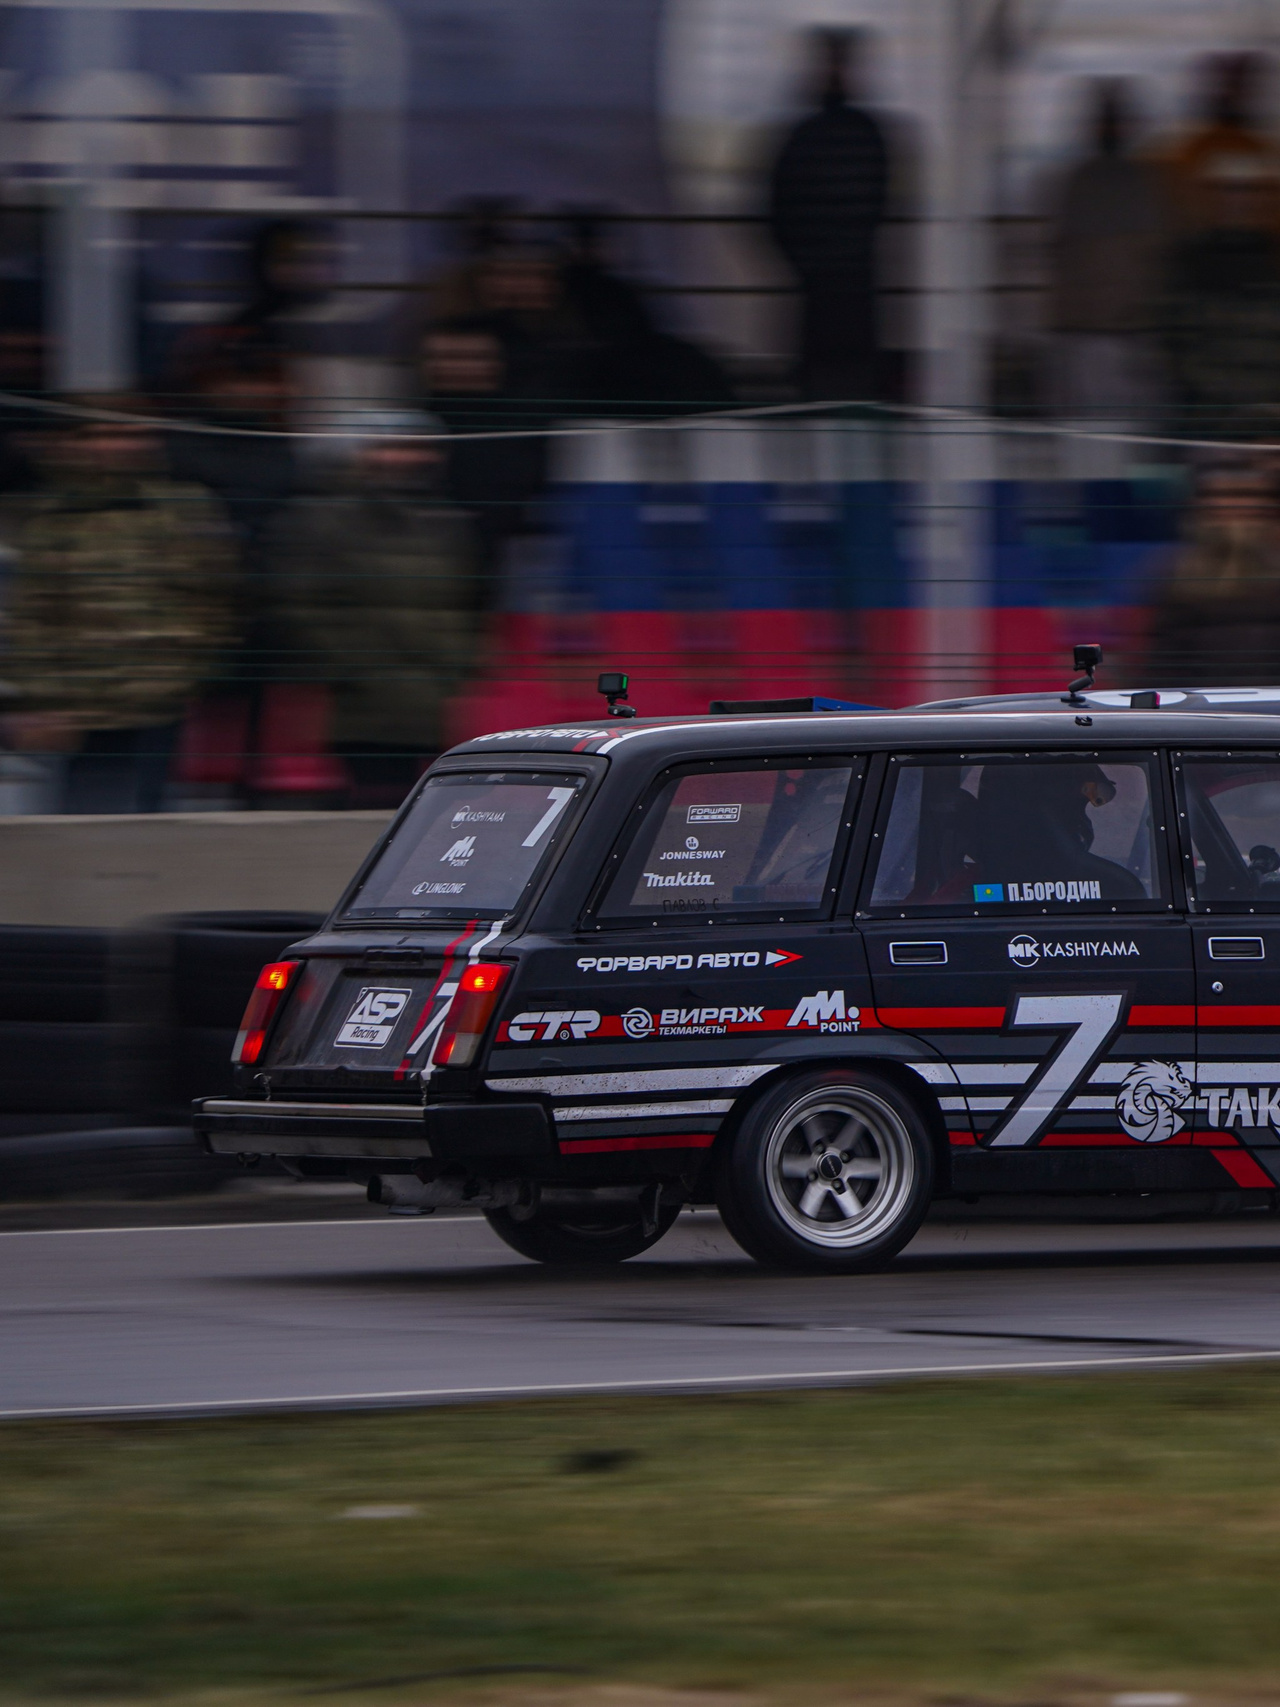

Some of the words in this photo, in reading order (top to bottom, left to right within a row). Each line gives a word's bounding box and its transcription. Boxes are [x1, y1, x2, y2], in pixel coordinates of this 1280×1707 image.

[466, 811, 506, 823] KASHIYAMA
[521, 787, 576, 847] 7
[690, 807, 738, 815] FORWARD
[450, 858, 469, 867] POINT
[659, 850, 726, 860] JONNESWAY
[426, 882, 466, 894] LINGLONG
[1007, 881, 1101, 902] П.БОРОДИН
[1043, 941, 1140, 957] KASHIYAMA
[577, 954, 693, 972] ФОРВАРД
[697, 952, 760, 968] АВТО
[347, 992, 407, 1024] ASP
[659, 1006, 765, 1025] ВИРАЖ
[508, 1010, 600, 1041] CTR
[658, 1024, 727, 1036] ТЕХМАРКЕТЫ
[820, 1021, 860, 1033] POINT
[350, 1026, 379, 1041] Racing
[990, 995, 1122, 1146] 7
